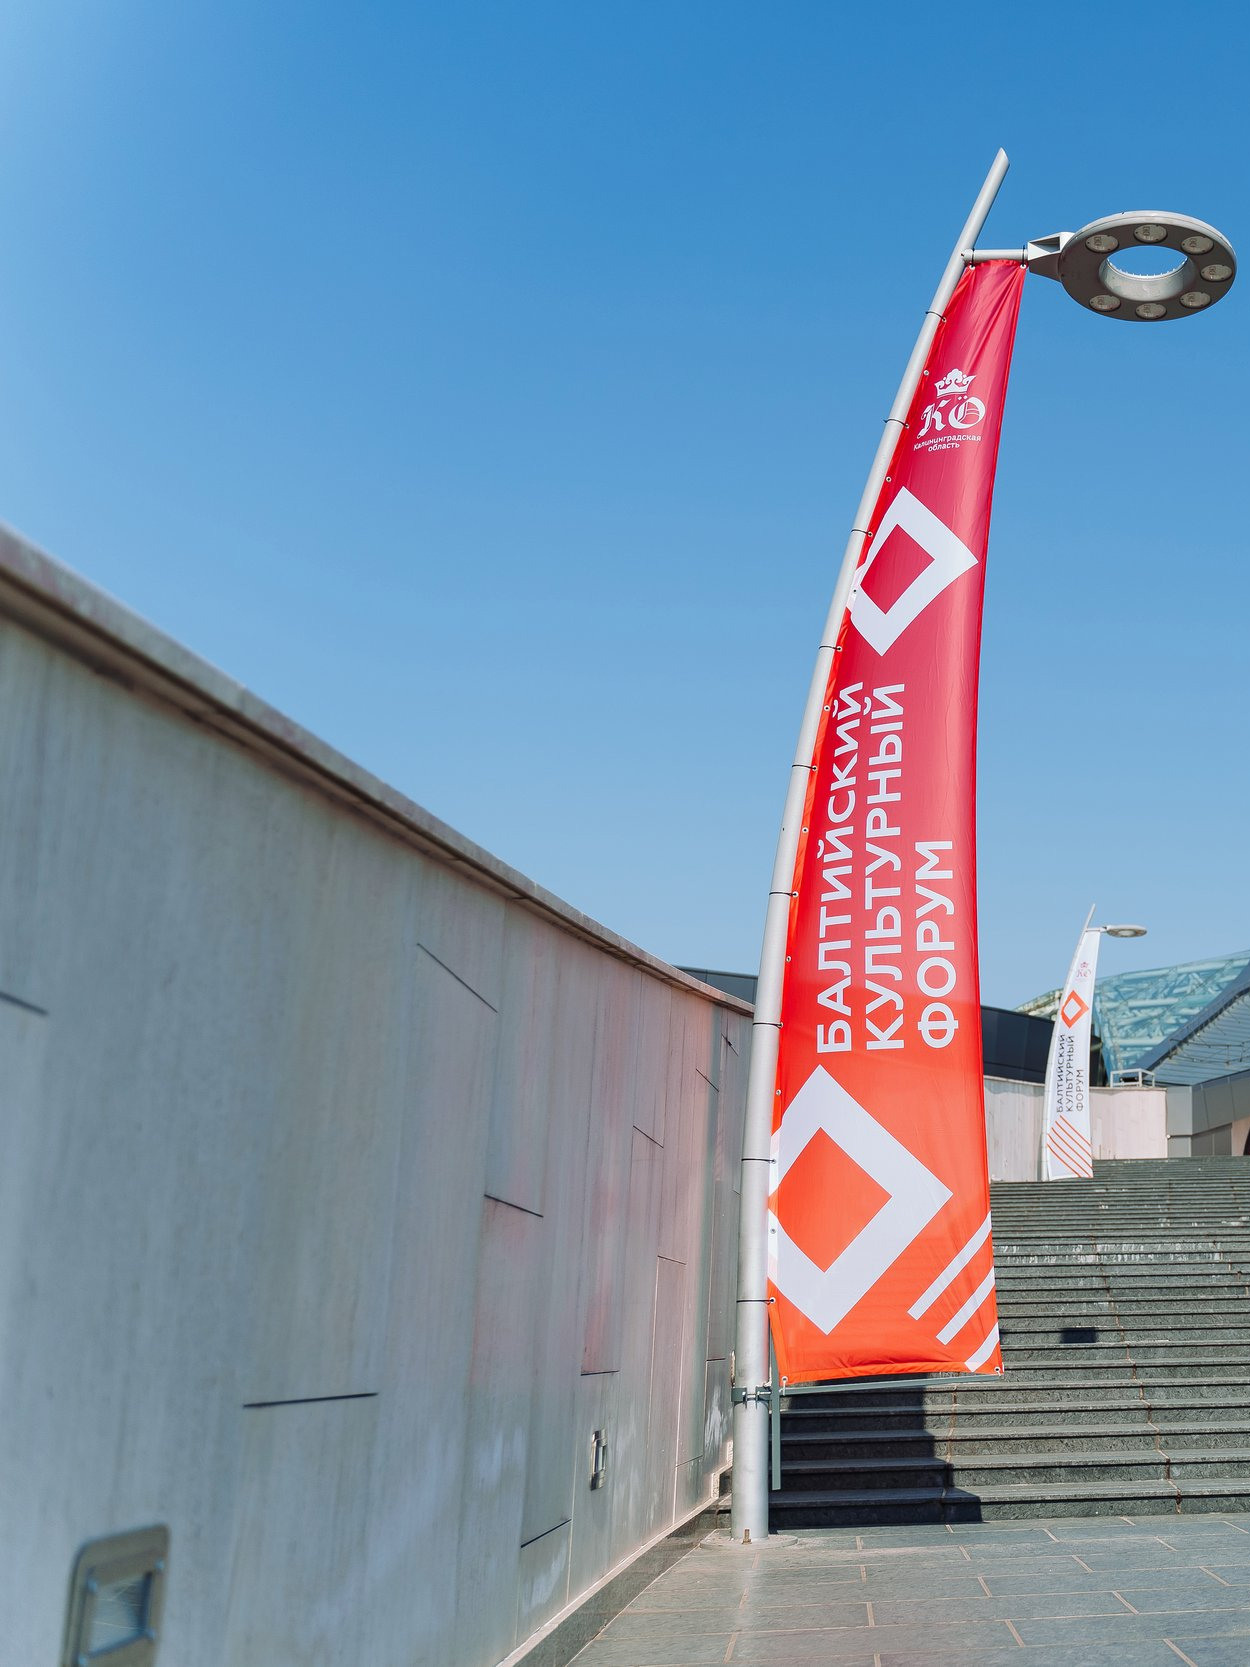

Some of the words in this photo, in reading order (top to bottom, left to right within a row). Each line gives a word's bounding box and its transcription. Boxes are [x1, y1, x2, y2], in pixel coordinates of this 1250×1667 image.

[928, 443, 960, 452] область
[816, 681, 864, 1054] БАЛТИЙСКИЙ
[863, 683, 905, 1050] КУЛЬТУРНЫЙ
[915, 840, 958, 1049] ФОРУМ
[1056, 1034, 1065, 1113] БАЛТИЙСКИЙ
[1066, 1035, 1074, 1112] КУЛЬТУРНЫЙ
[1075, 1069, 1084, 1112] ФОРУМ
